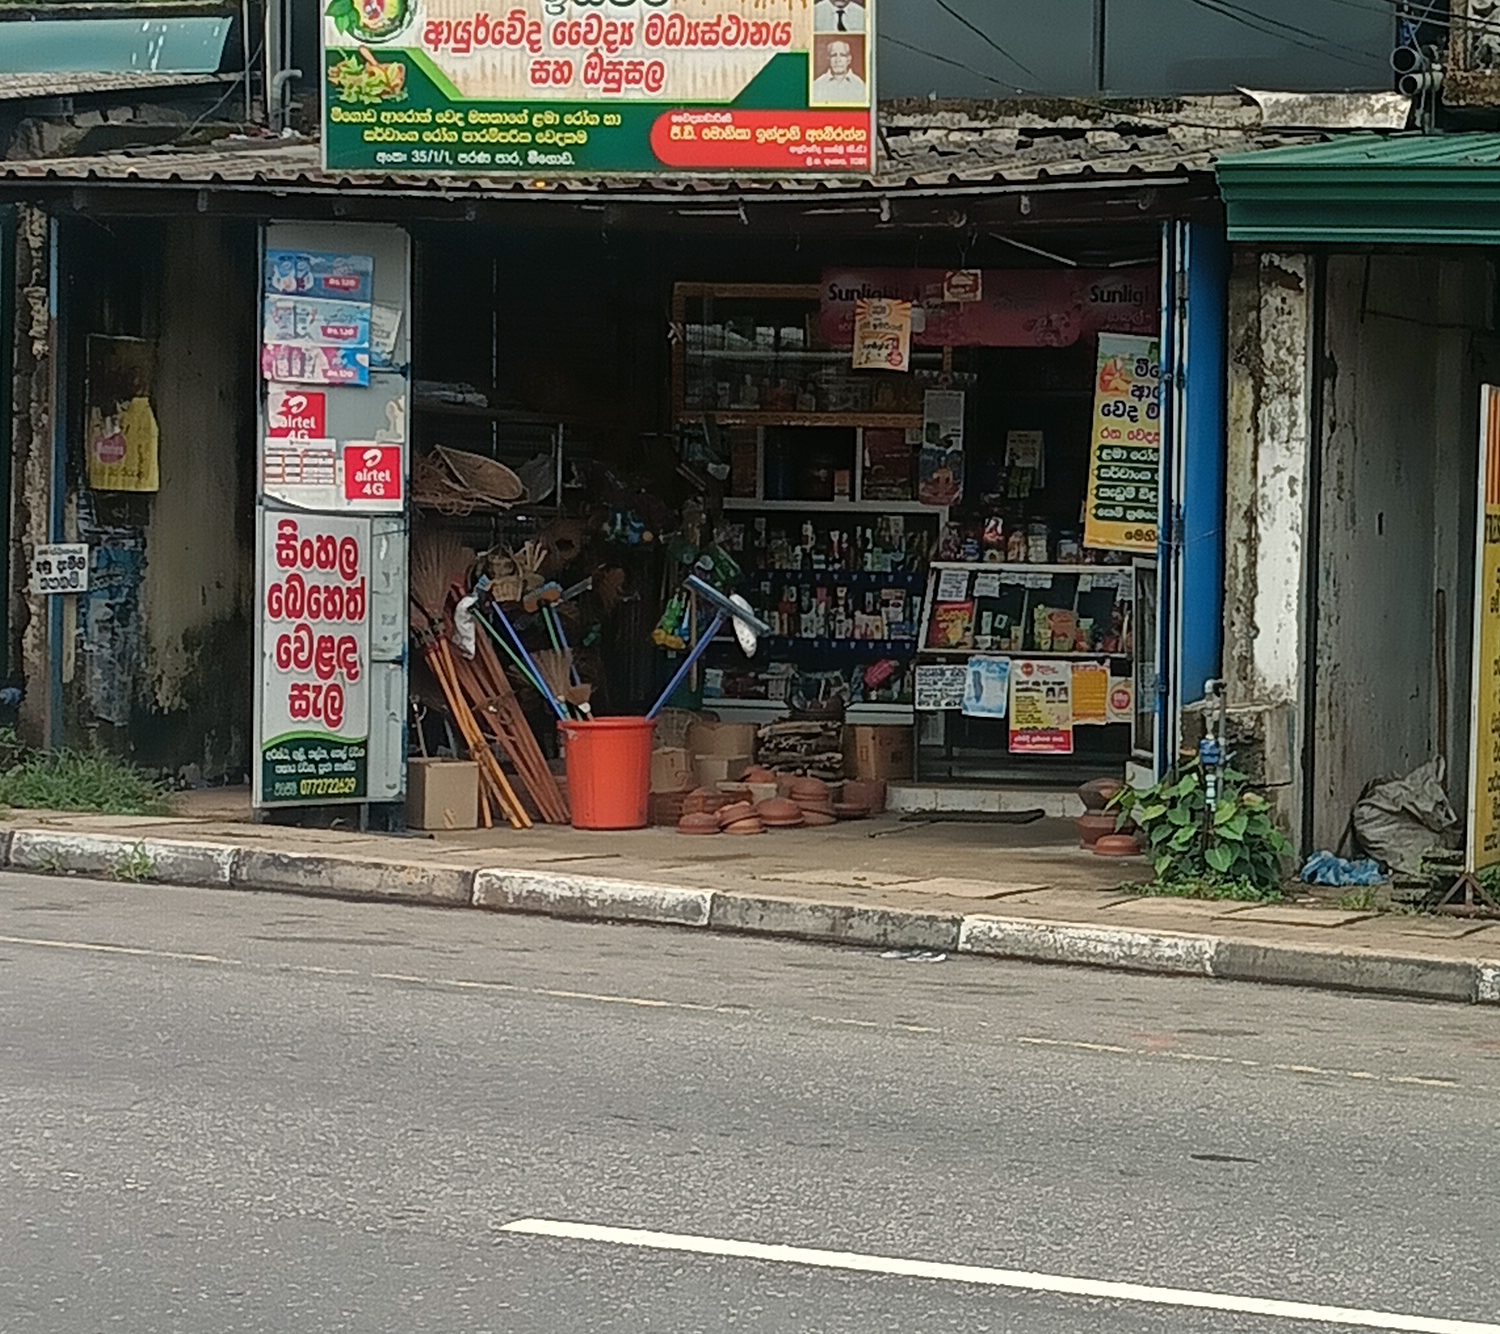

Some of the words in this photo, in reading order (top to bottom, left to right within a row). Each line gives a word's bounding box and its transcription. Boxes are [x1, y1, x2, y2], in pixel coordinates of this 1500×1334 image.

[422, 9, 543, 54] ආයුර්වේද
[530, 59, 574, 85] සහ
[354, 469, 391, 483] airtel
[362, 482, 385, 496] 4G
[275, 519, 359, 582] සිංහල
[267, 572, 367, 621] බෙහෙත්
[288, 682, 344, 729] සැල
